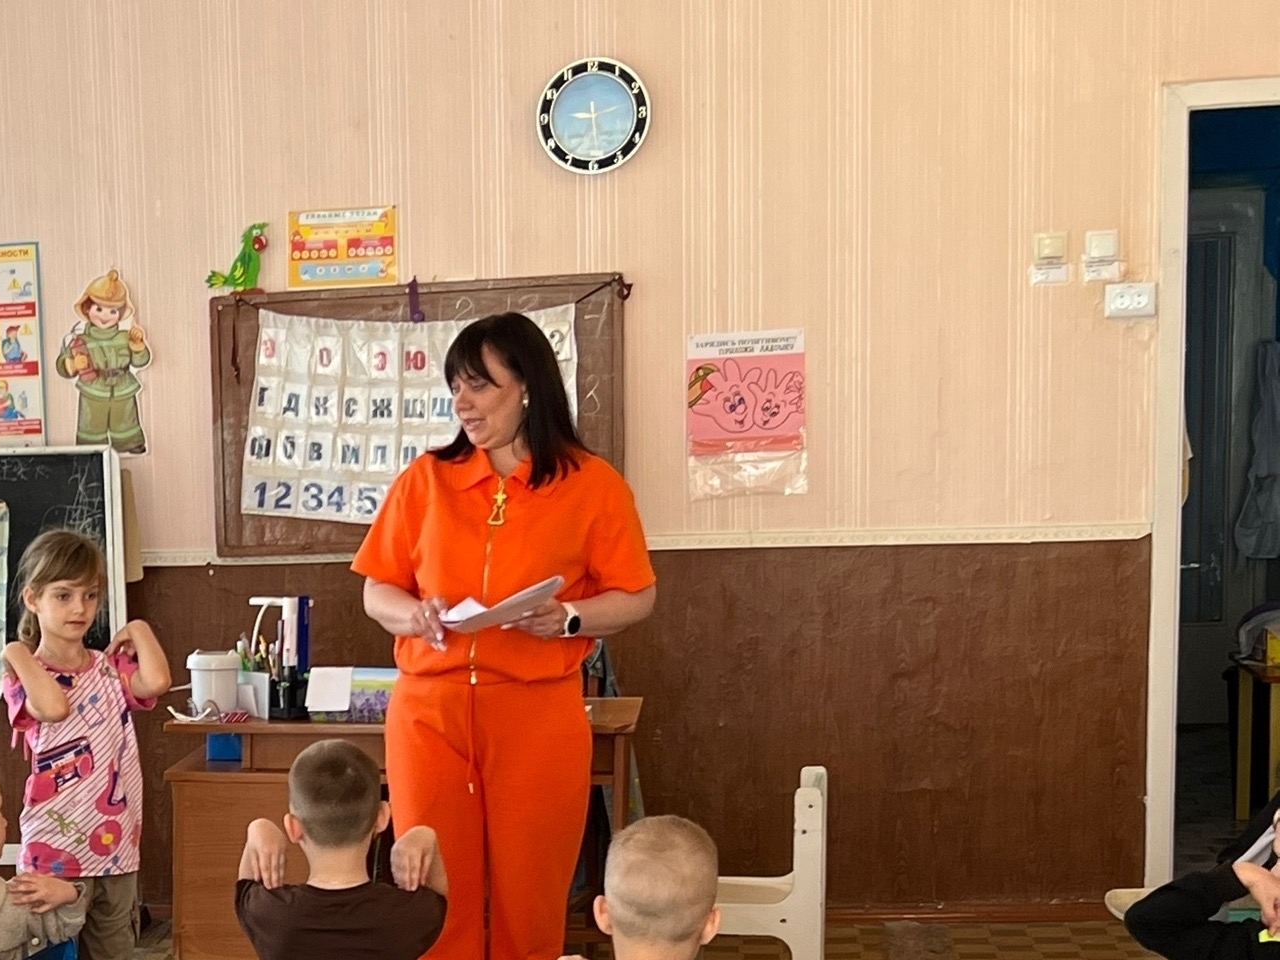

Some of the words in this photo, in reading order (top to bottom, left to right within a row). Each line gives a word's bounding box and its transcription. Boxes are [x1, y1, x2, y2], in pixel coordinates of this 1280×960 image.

[587, 61, 599, 72] 12
[614, 65, 620, 77] 1
[631, 81, 641, 94] 2
[637, 105, 647, 119] 3
[540, 113, 549, 126] 9
